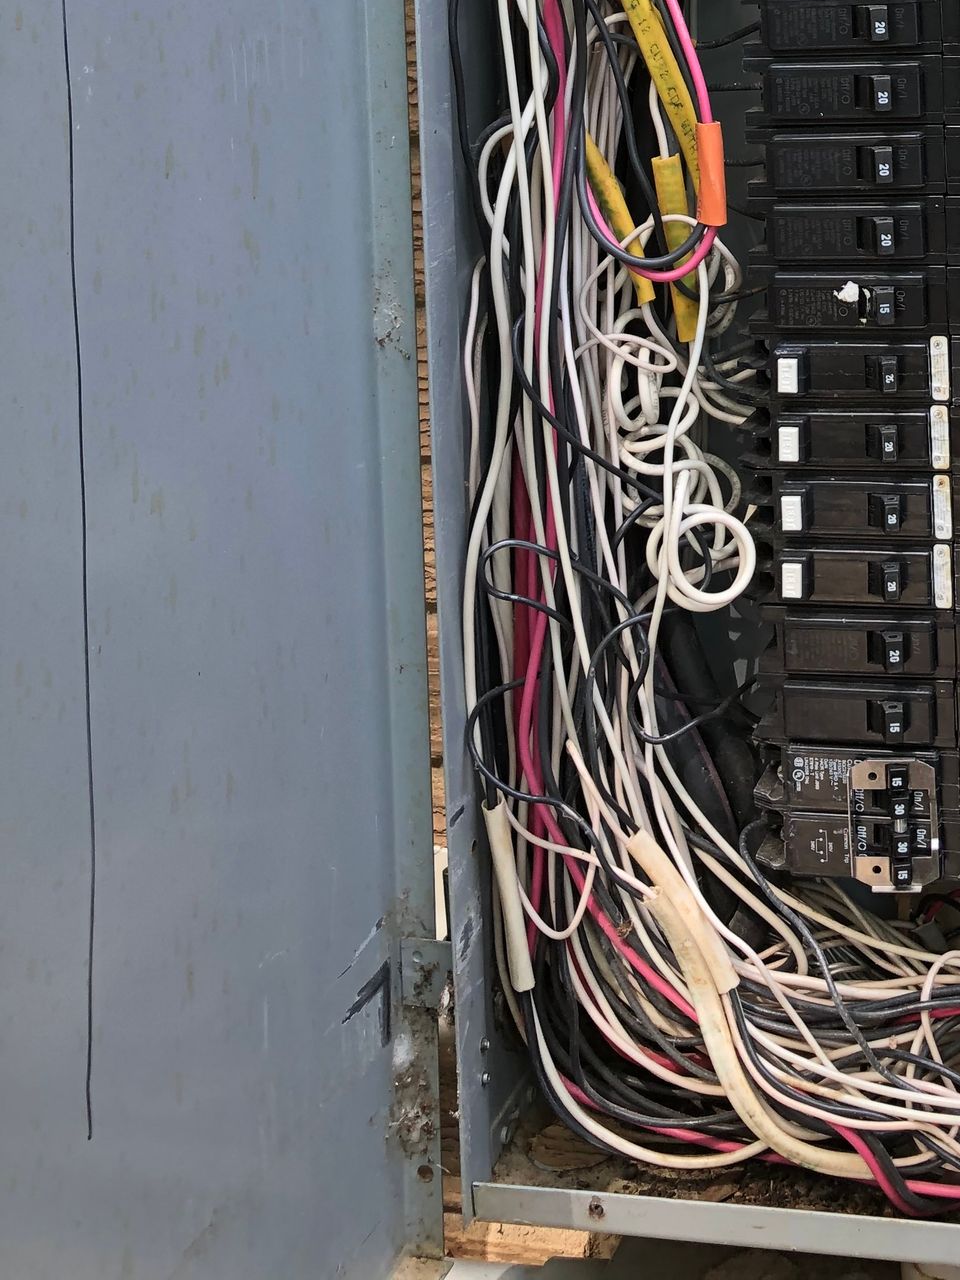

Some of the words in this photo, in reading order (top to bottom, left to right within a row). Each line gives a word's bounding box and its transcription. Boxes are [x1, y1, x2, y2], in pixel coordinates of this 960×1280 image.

[874, 22, 885, 34] 20
[878, 91, 888, 104] 20
[879, 163, 890, 176] 20
[881, 234, 891, 247] 20
[880, 303, 890, 314] 15
[884, 442, 893, 451] 20
[888, 514, 897, 525] 20
[888, 581, 896, 592] 20
[889, 650, 900, 663] 20
[889, 722, 900, 733] 15
[892, 777, 902, 787] 15
[895, 803, 905, 816] 30
[898, 841, 907, 853] 30
[898, 870, 907, 880] 15
